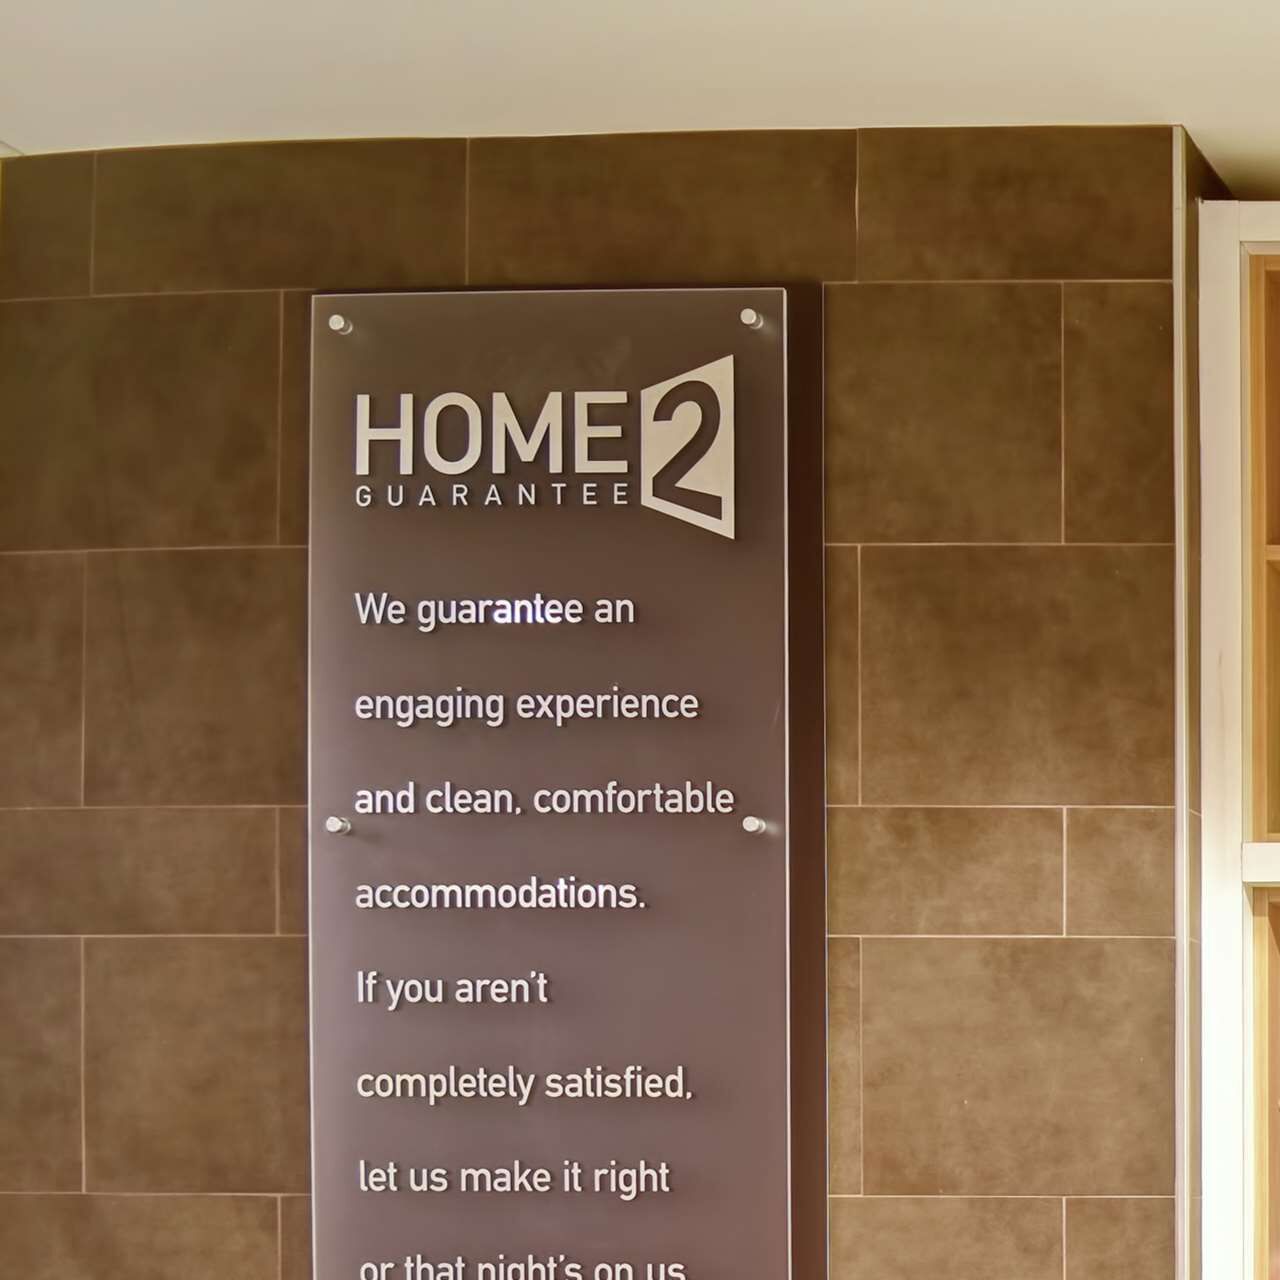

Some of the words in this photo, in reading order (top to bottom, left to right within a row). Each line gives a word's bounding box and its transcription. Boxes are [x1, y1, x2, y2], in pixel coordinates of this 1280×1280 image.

[355, 391, 628, 475] HOME
[355, 482, 629, 508] GUARANTEE
[354, 592, 406, 624] We
[417, 592, 583, 632] guarantee
[594, 599, 634, 624] an
[354, 685, 504, 727] engaging
[516, 686, 699, 726] experience
[355, 781, 415, 814] and
[425, 781, 522, 816] clean,
[533, 780, 734, 814] comfortable
[355, 875, 646, 909] accommodations.
[357, 971, 377, 1003] If
[386, 978, 443, 1011] you
[455, 971, 548, 1003] aren't
[356, 1065, 535, 1106] completely
[545, 1066, 692, 1100] satisfied,
[359, 1160, 398, 1192] let
[409, 1167, 448, 1192] us
[460, 1160, 551, 1192] make
[563, 1160, 582, 1192] it
[594, 1160, 670, 1200] right
